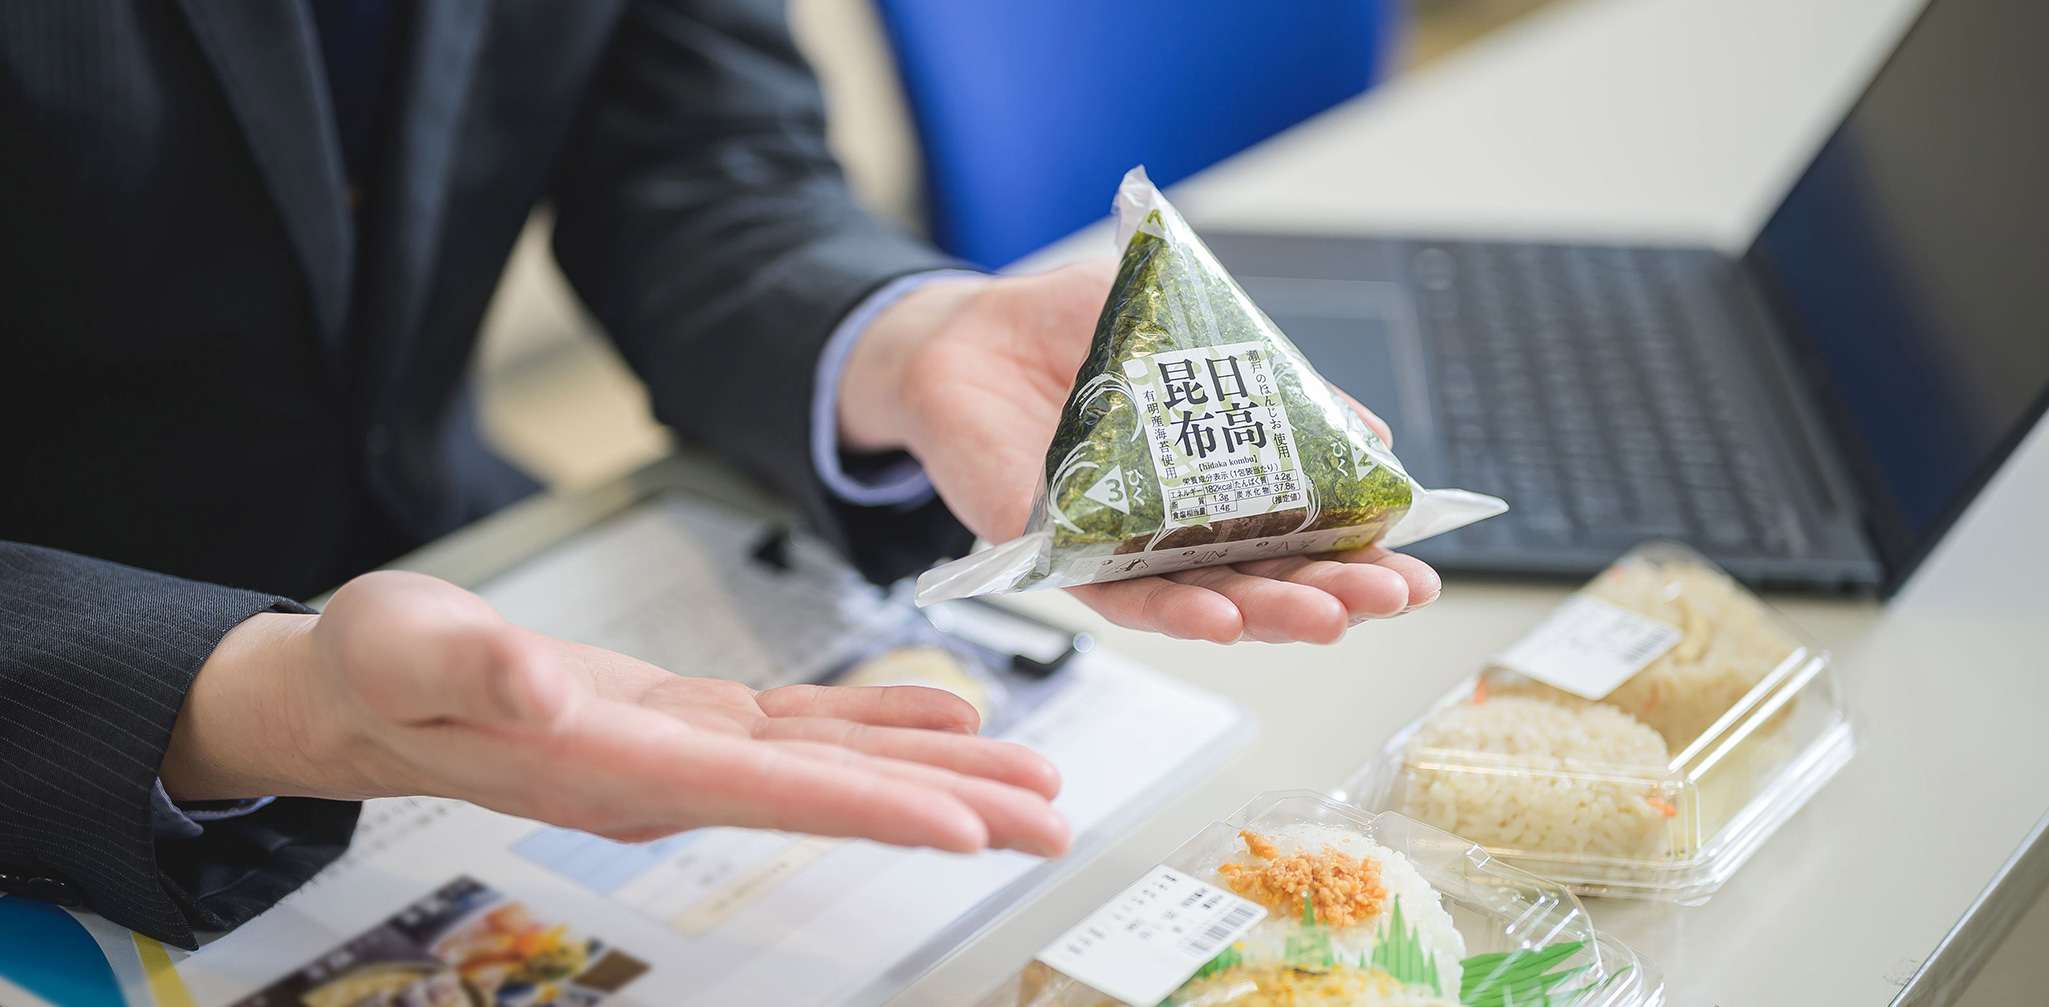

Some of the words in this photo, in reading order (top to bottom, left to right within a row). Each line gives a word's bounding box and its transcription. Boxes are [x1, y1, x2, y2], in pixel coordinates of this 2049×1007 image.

[1158, 358, 1217, 458] 昆布
[1205, 355, 1267, 454] 日高
[1143, 390, 1177, 479] 有明産海苔使用
[1330, 441, 1349, 477] ひく
[1105, 479, 1124, 502] 3
[1125, 469, 1146, 506] ひく
[1205, 482, 1232, 493] 182kcal
[1274, 472, 1292, 481] 4.2g
[1213, 493, 1230, 502] 1.3g
[1273, 482, 1296, 493] 37.8g
[1214, 504, 1231, 513] 1.4g
